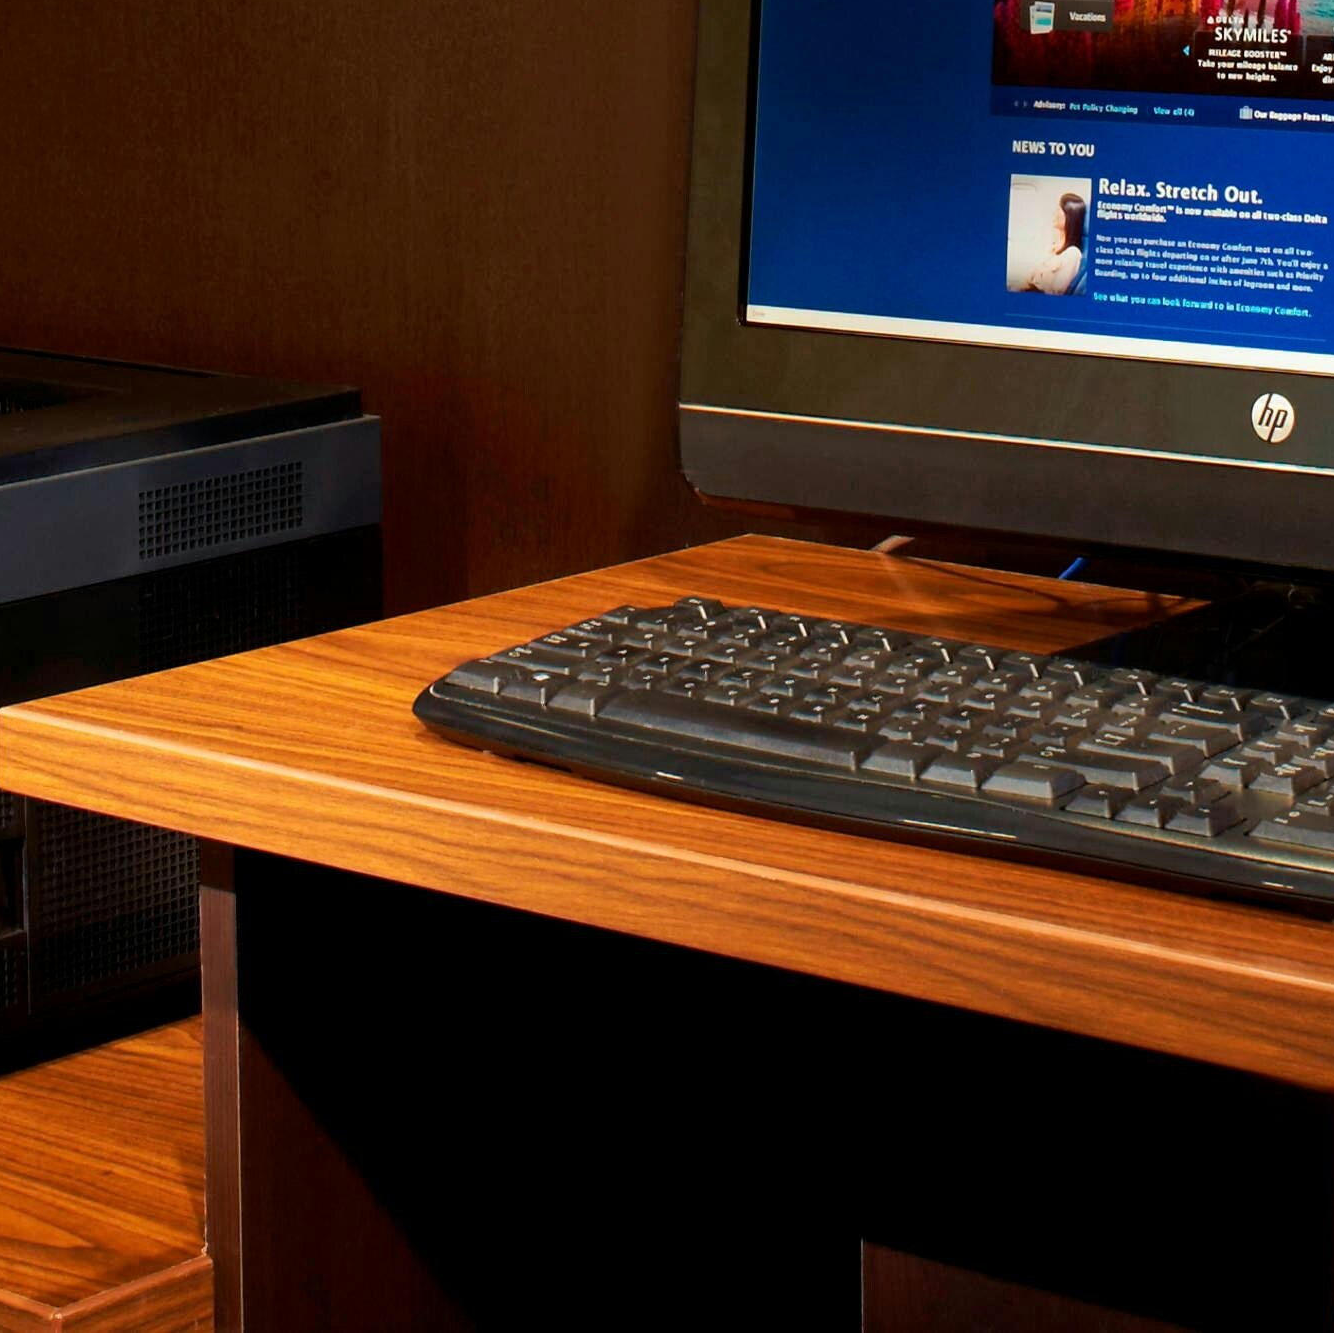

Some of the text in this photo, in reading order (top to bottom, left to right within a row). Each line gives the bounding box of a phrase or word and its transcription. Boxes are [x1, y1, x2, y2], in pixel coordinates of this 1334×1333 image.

[1070, 12, 1106, 22] Vacations
[1013, 141, 1094, 157] NEWS TO YOU
[1099, 178, 1263, 204] Relax. Stretch Out.
[1257, 393, 1289, 444] hp
